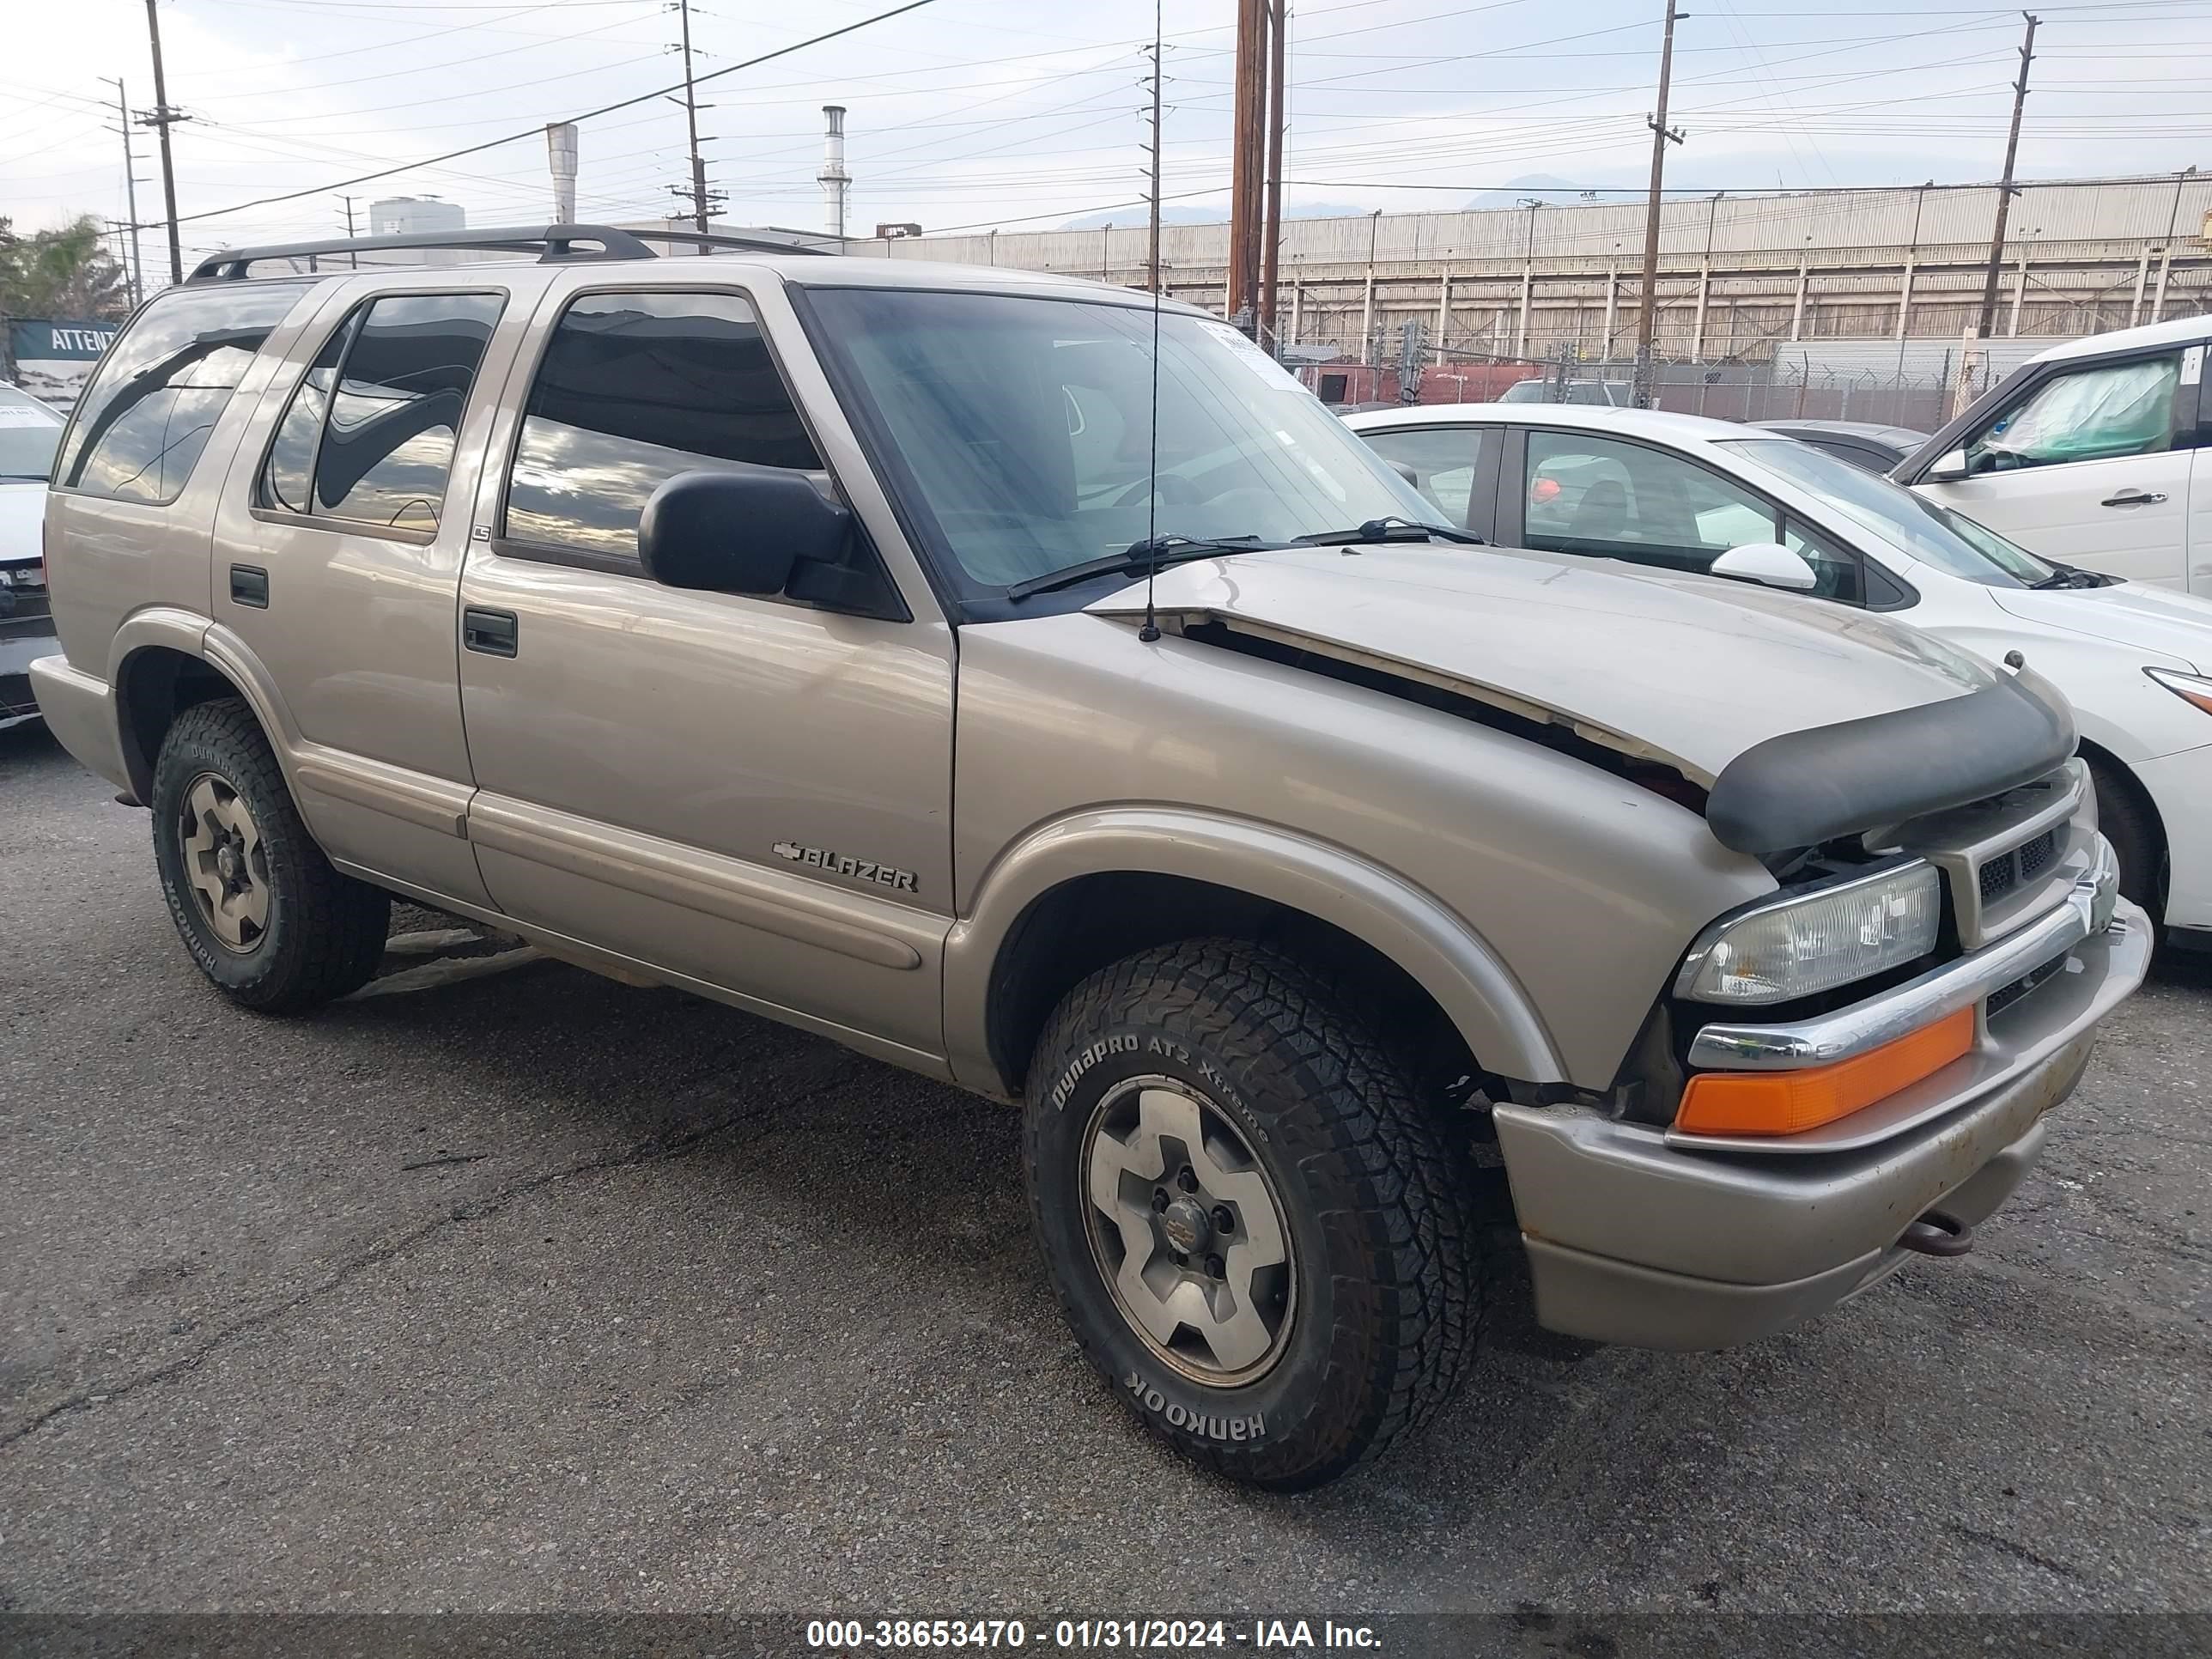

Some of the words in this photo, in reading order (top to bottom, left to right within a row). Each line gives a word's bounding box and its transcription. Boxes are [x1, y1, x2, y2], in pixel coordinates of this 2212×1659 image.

[803, 848, 917, 893] BLAZER
[1147, 1036, 1191, 1066] AT2
[1198, 1060, 1269, 1144] Xtreme
